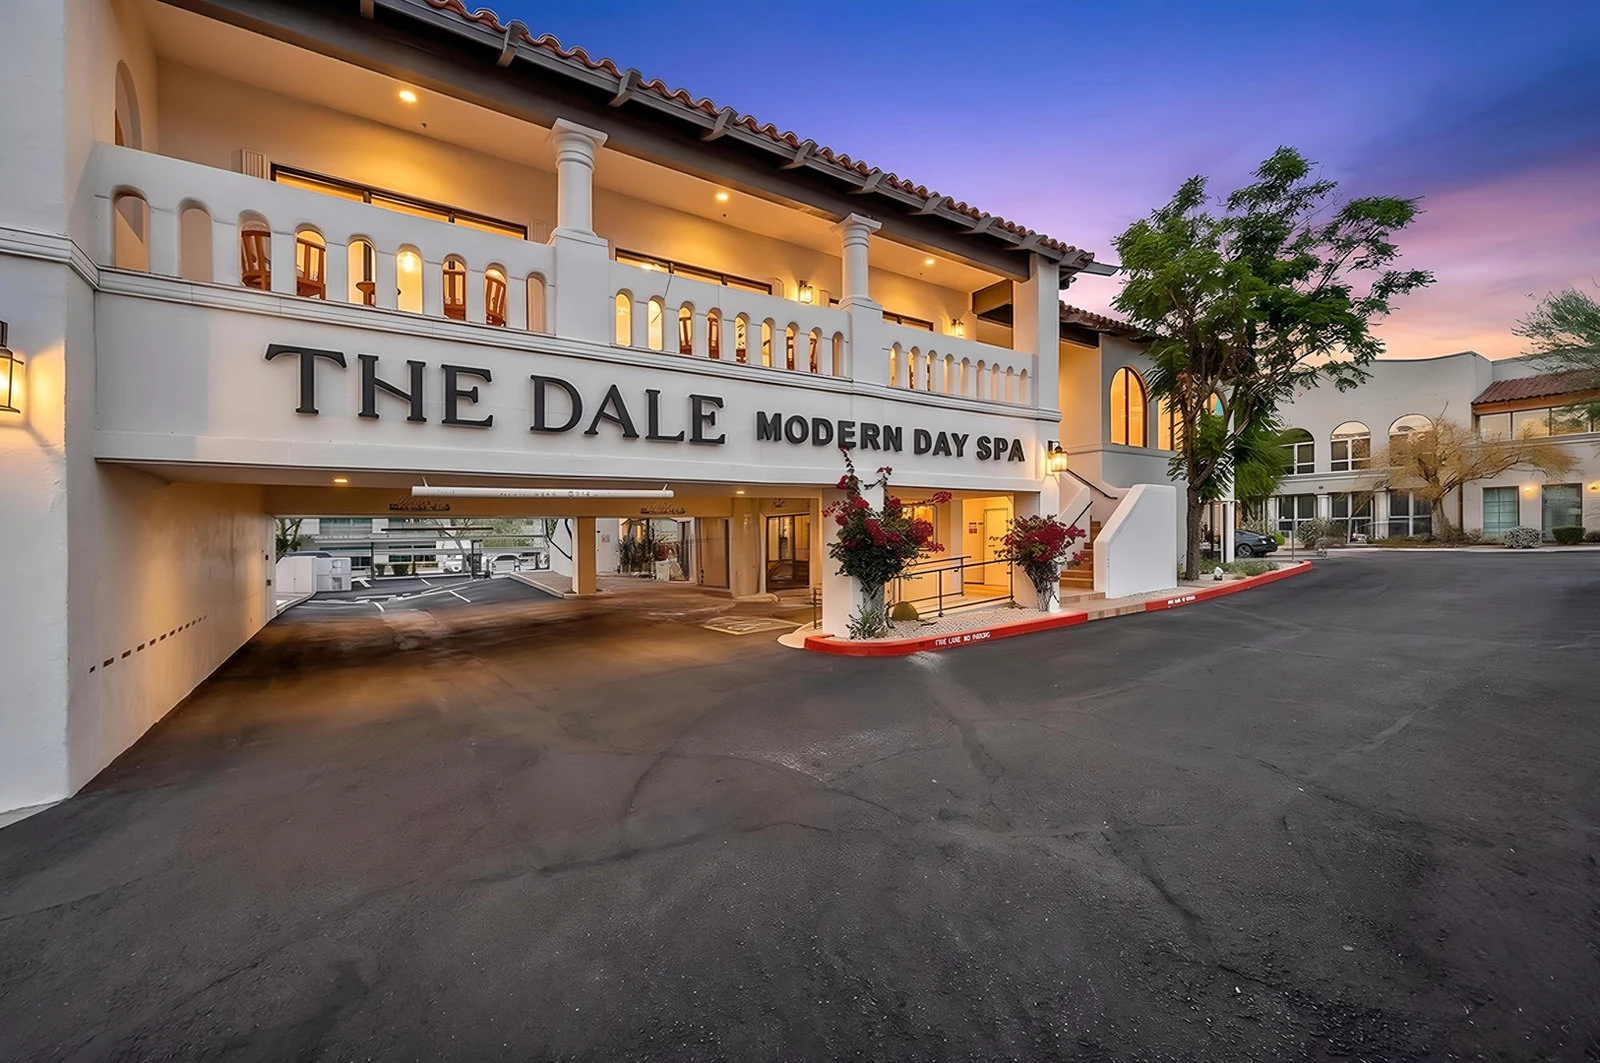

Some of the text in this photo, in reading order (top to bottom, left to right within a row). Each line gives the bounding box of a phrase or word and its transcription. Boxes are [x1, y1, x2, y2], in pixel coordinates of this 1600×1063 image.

[265, 343, 1026, 463] THE DALE MODERN DAY SPA
